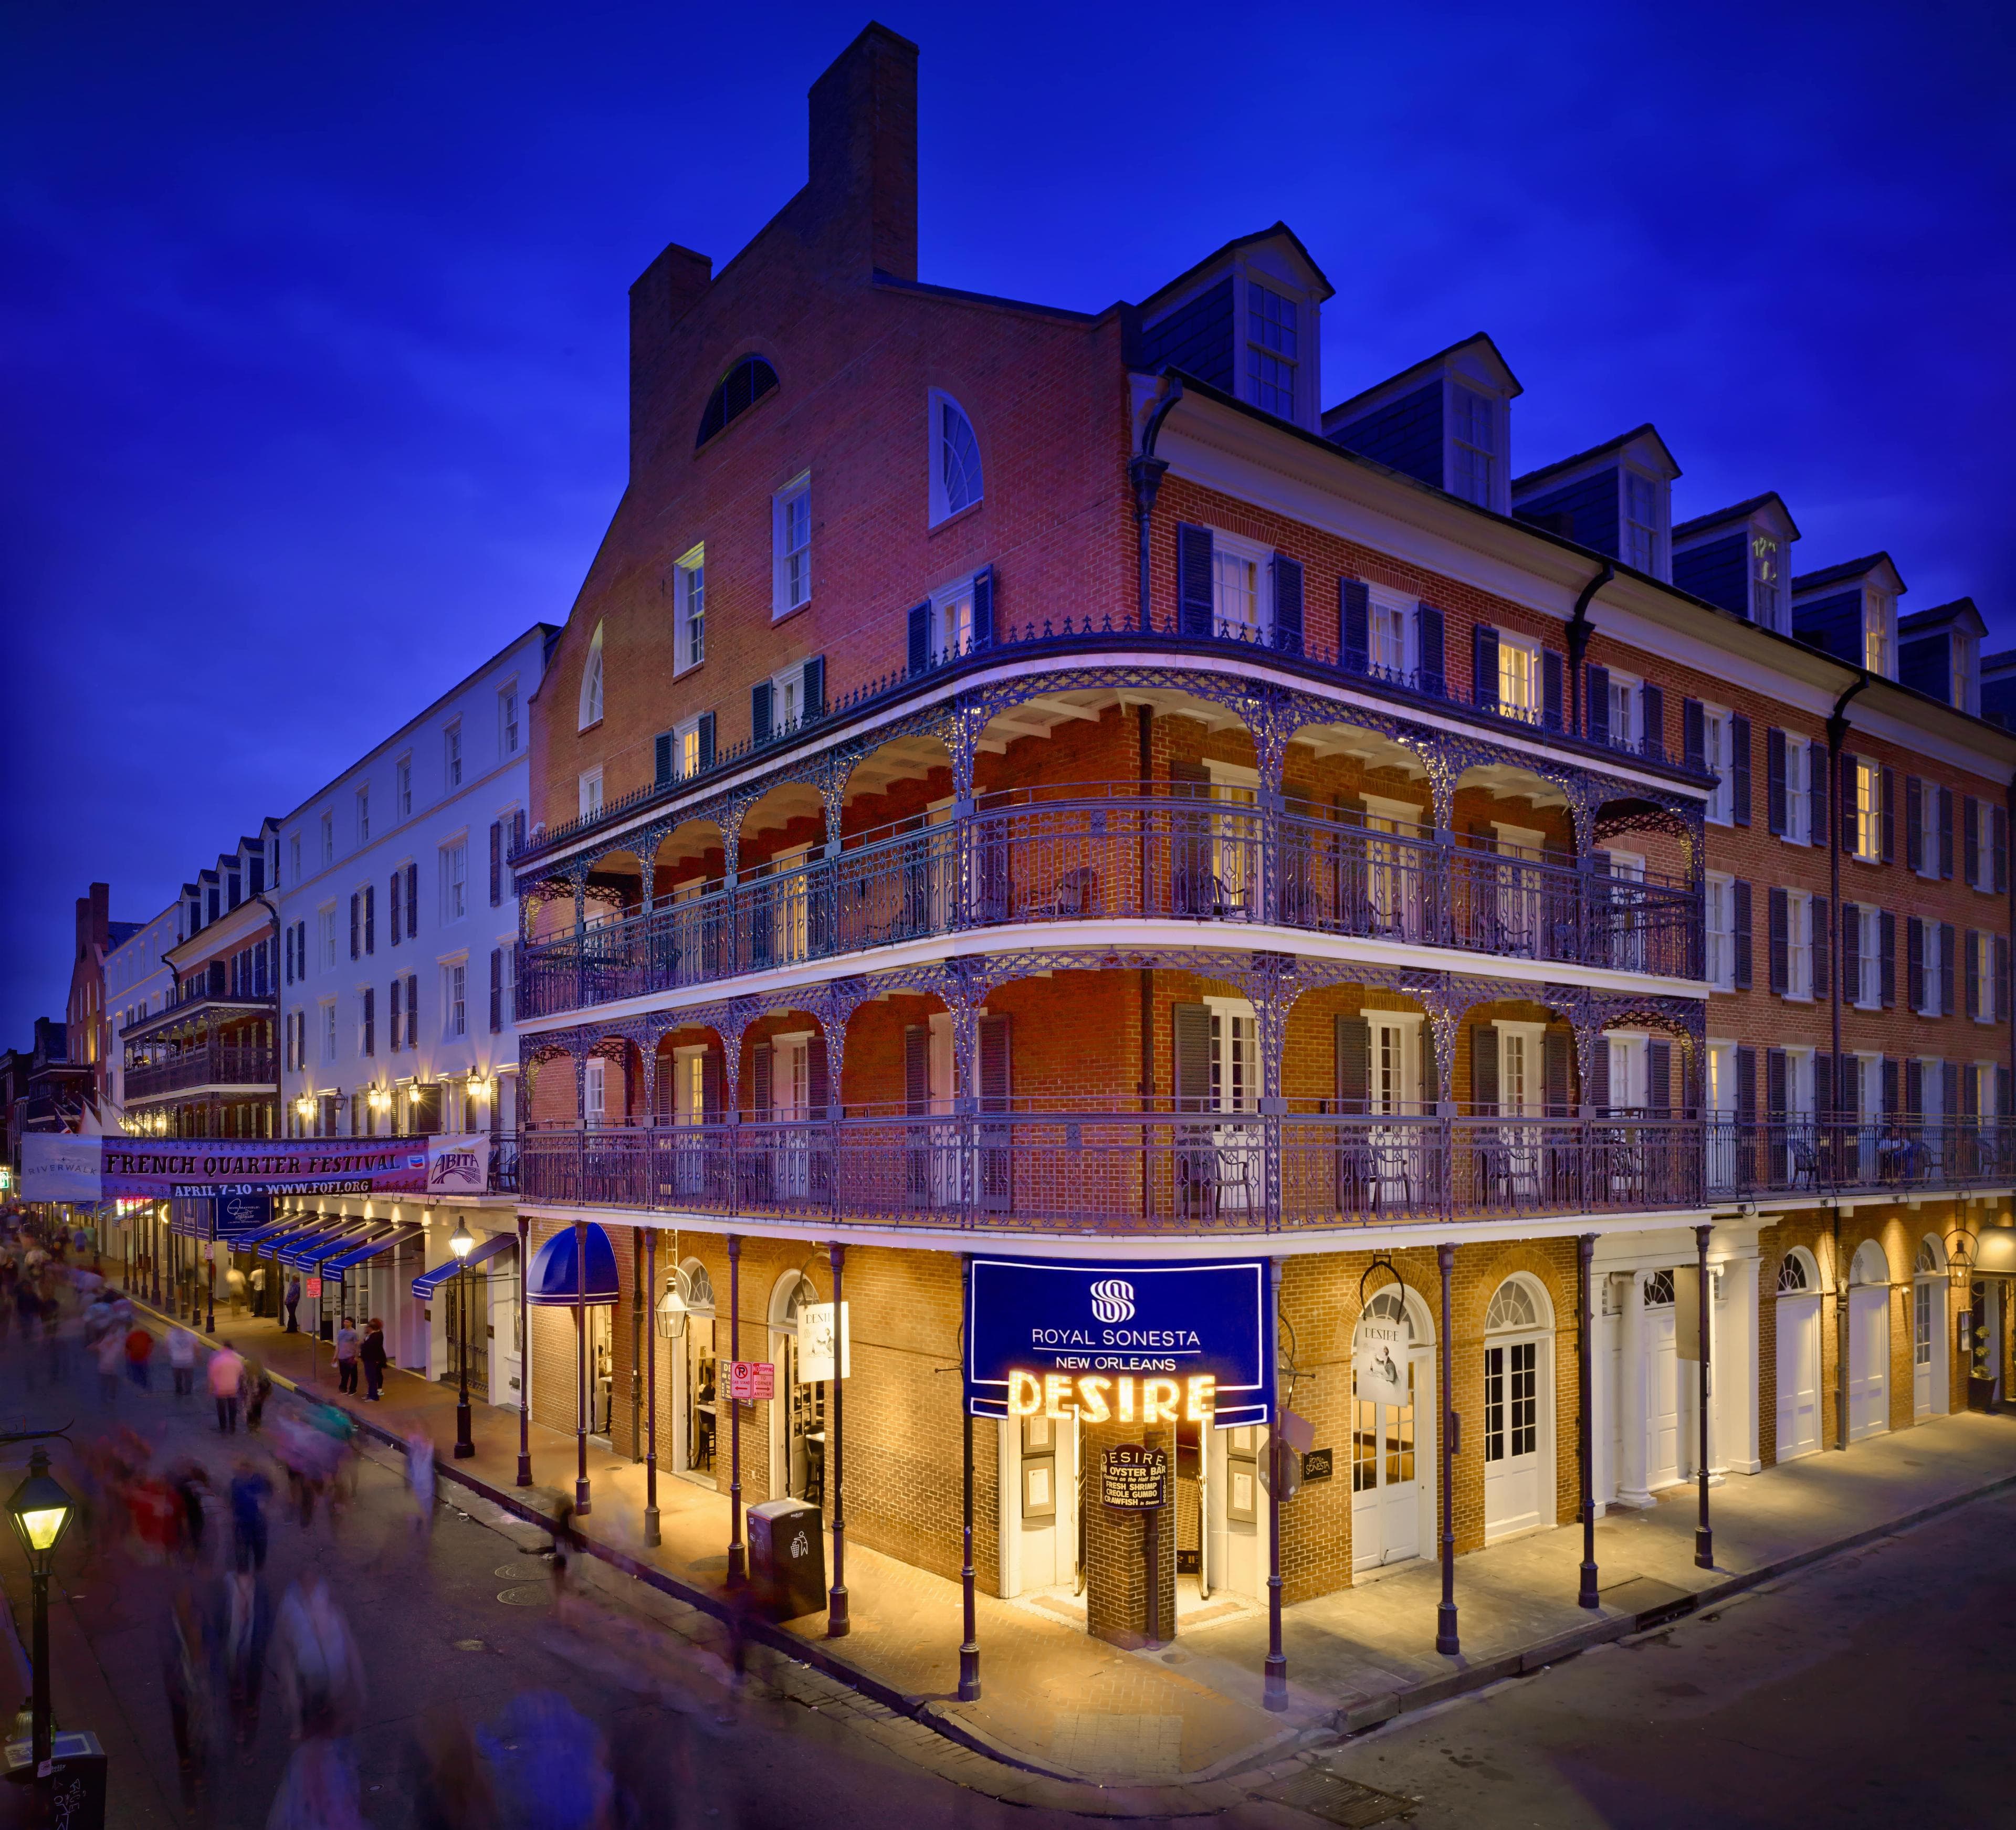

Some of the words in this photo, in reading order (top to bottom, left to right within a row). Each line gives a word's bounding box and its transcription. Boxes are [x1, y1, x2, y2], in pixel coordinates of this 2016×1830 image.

[28, 1164, 97, 1175] RIVERWALK
[105, 1154, 198, 1175] FRENCH
[203, 1156, 302, 1177] QUARTER
[308, 1155, 402, 1173] FESTIVAL
[431, 1154, 479, 1181] ABITA
[175, 1185, 215, 1197] APRIL
[266, 1181, 369, 1195] WWW.FQFI.ORG
[1032, 1329, 1096, 1345] ROYAL
[1102, 1330, 1201, 1347] SONESTA
[1365, 1327, 1399, 1342] DESIRE
[1056, 1356, 1090, 1369] NEW
[1095, 1357, 1177, 1371] ORLEANS
[1008, 1369, 1215, 1424] DESIRE
[1101, 1452, 1164, 1466] DESIRE
[1109, 1466, 1147, 1477] OYSTER
[1150, 1465, 1166, 1476] BAR
[1306, 1461, 1330, 1475] SONESTA
[1106, 1480, 1127, 1490] FRESH
[1106, 1488, 1129, 1498] CREOLE
[1132, 1490, 1158, 1498] GUMBO
[1104, 1495, 1138, 1506] CRAWFISH
